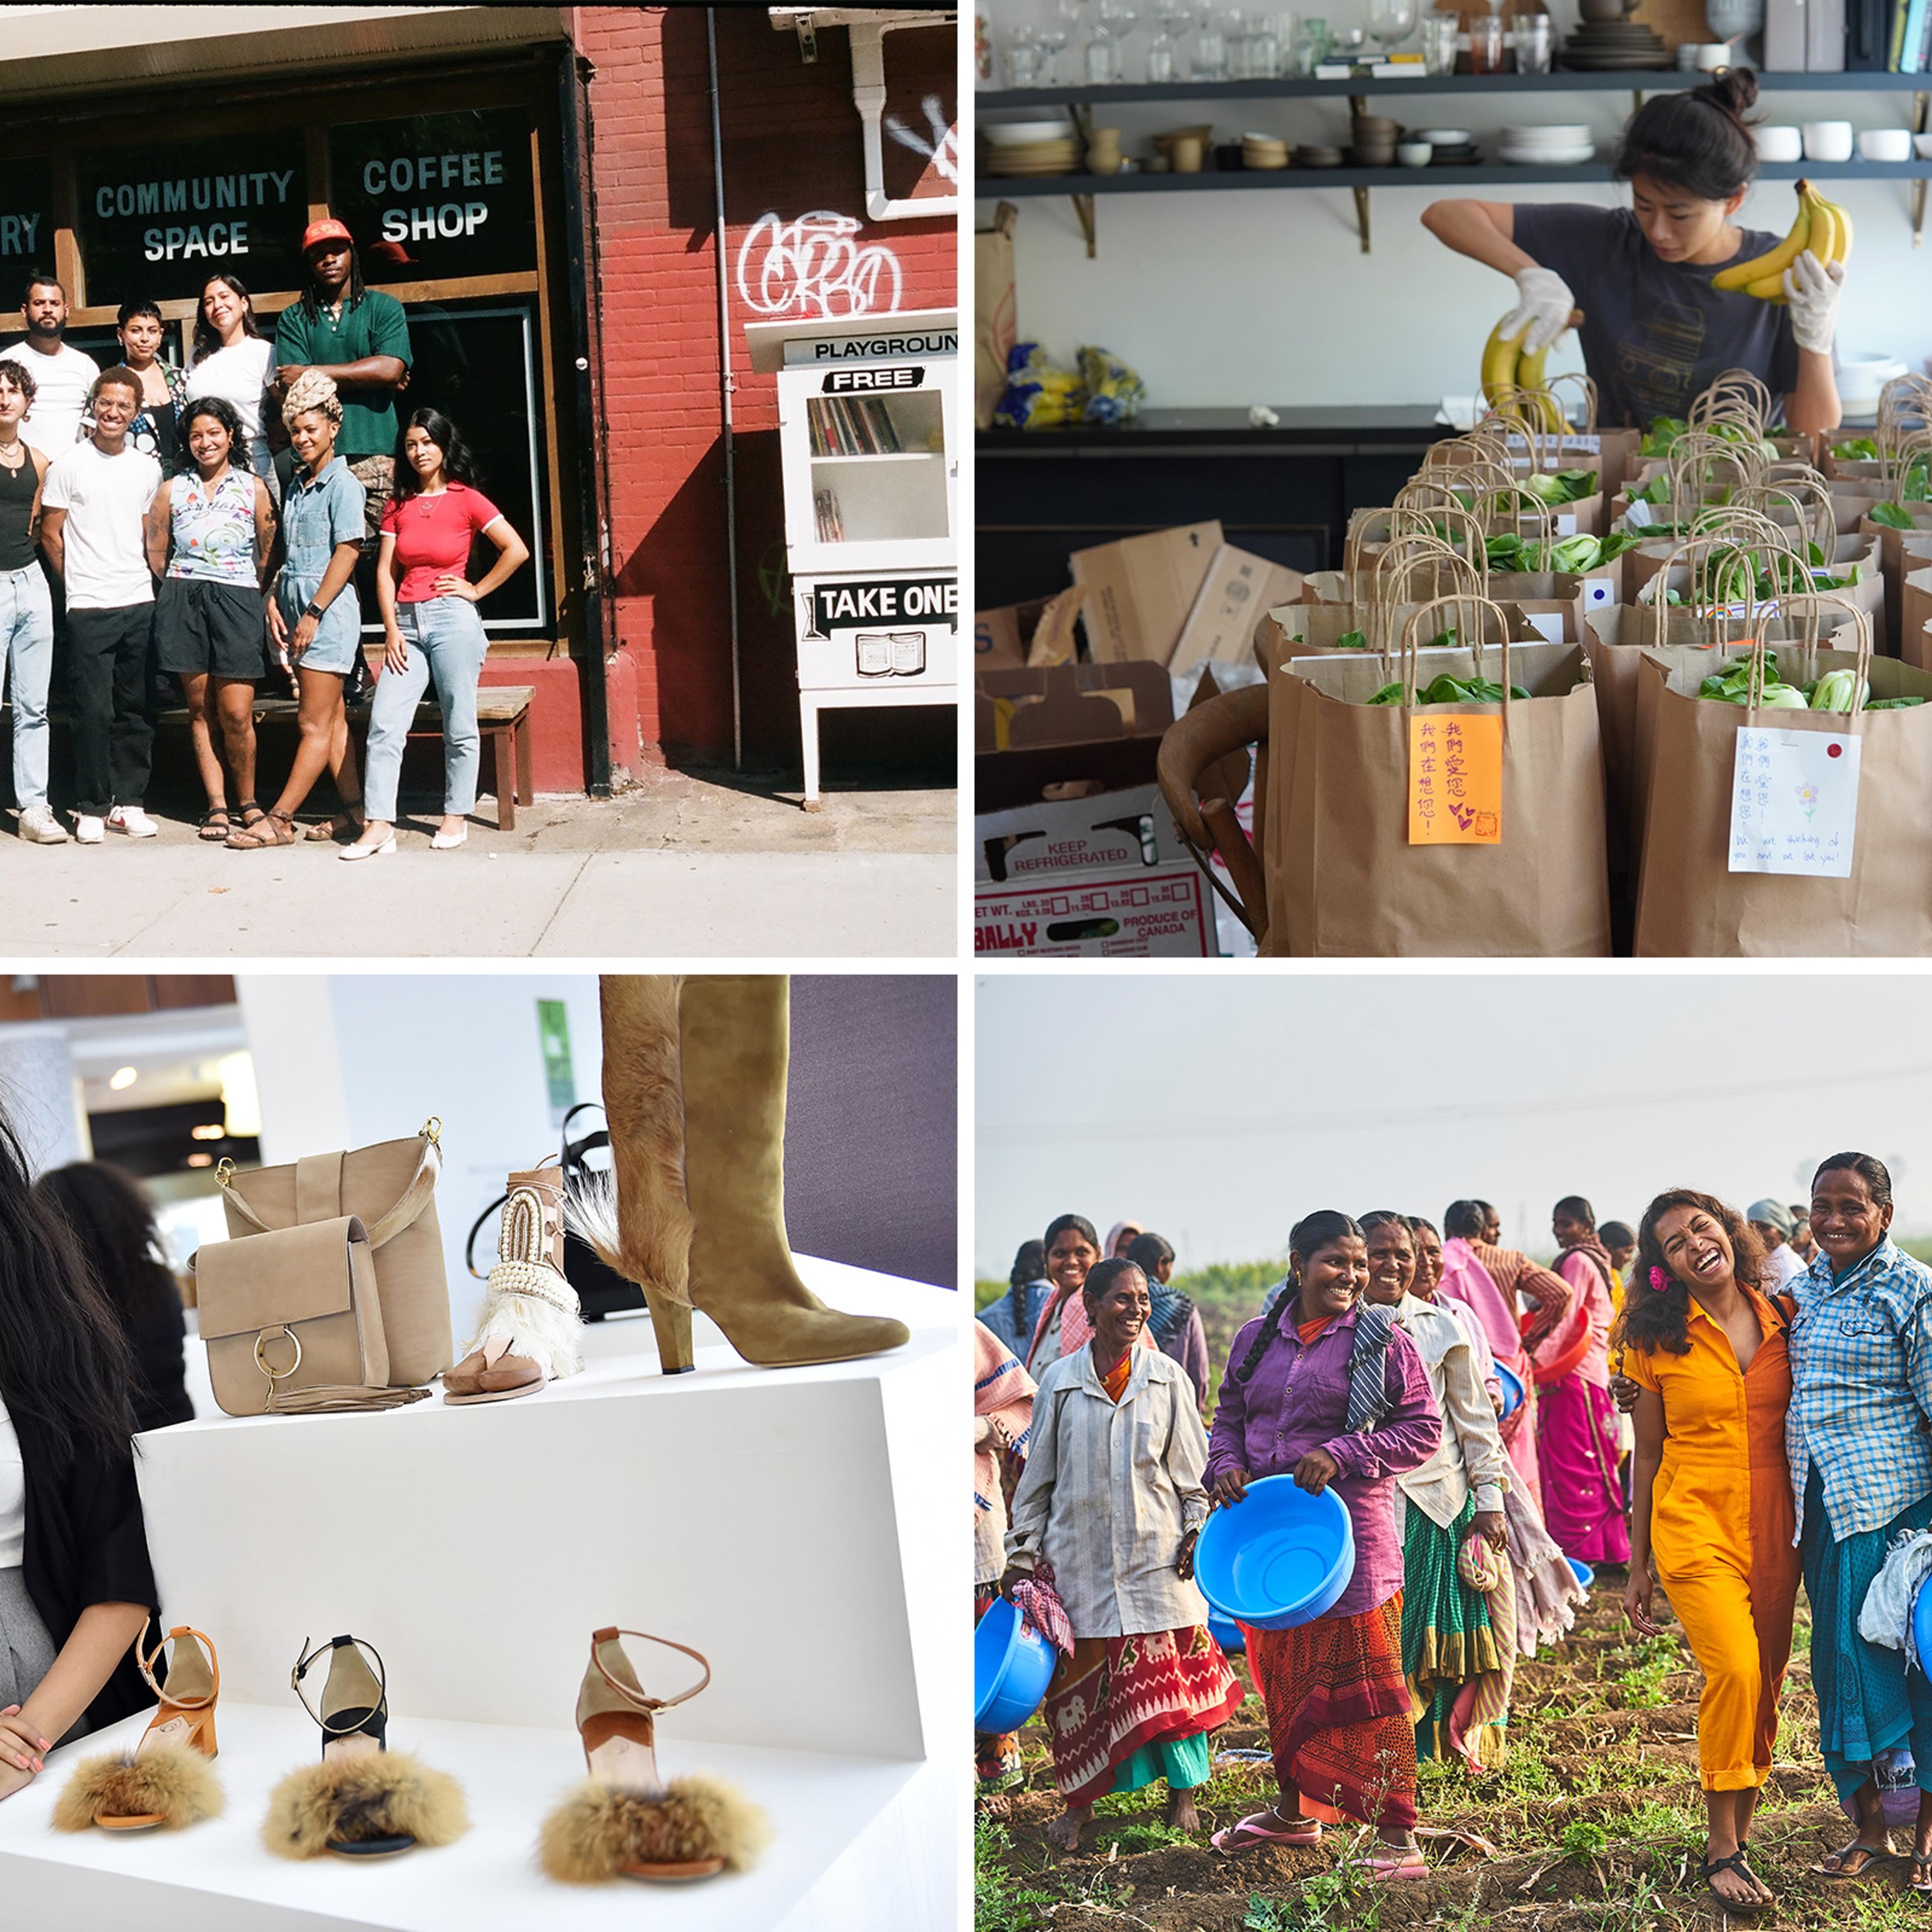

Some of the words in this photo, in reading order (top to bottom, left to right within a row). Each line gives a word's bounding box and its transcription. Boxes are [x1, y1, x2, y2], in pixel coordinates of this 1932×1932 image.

[363, 150, 503, 195] COFFEE
[96, 170, 294, 218] COMMUNITY
[1, 213, 40, 256] RY
[381, 202, 488, 243] SHOP
[144, 221, 249, 261] SPACE
[815, 334, 957, 359] PLAYGROUN
[833, 369, 913, 390] FREE
[820, 587, 897, 619] TAKE
[904, 584, 957, 616] ONE
[1014, 848, 1128, 871] REFRIGERATED
[1048, 840, 1087, 854] KEEP
[1123, 911, 1179, 927] PRODUCE
[1180, 909, 1197, 921] OF
[1138, 923, 1186, 937] CANADA
[975, 922, 1037, 951] BALLY
